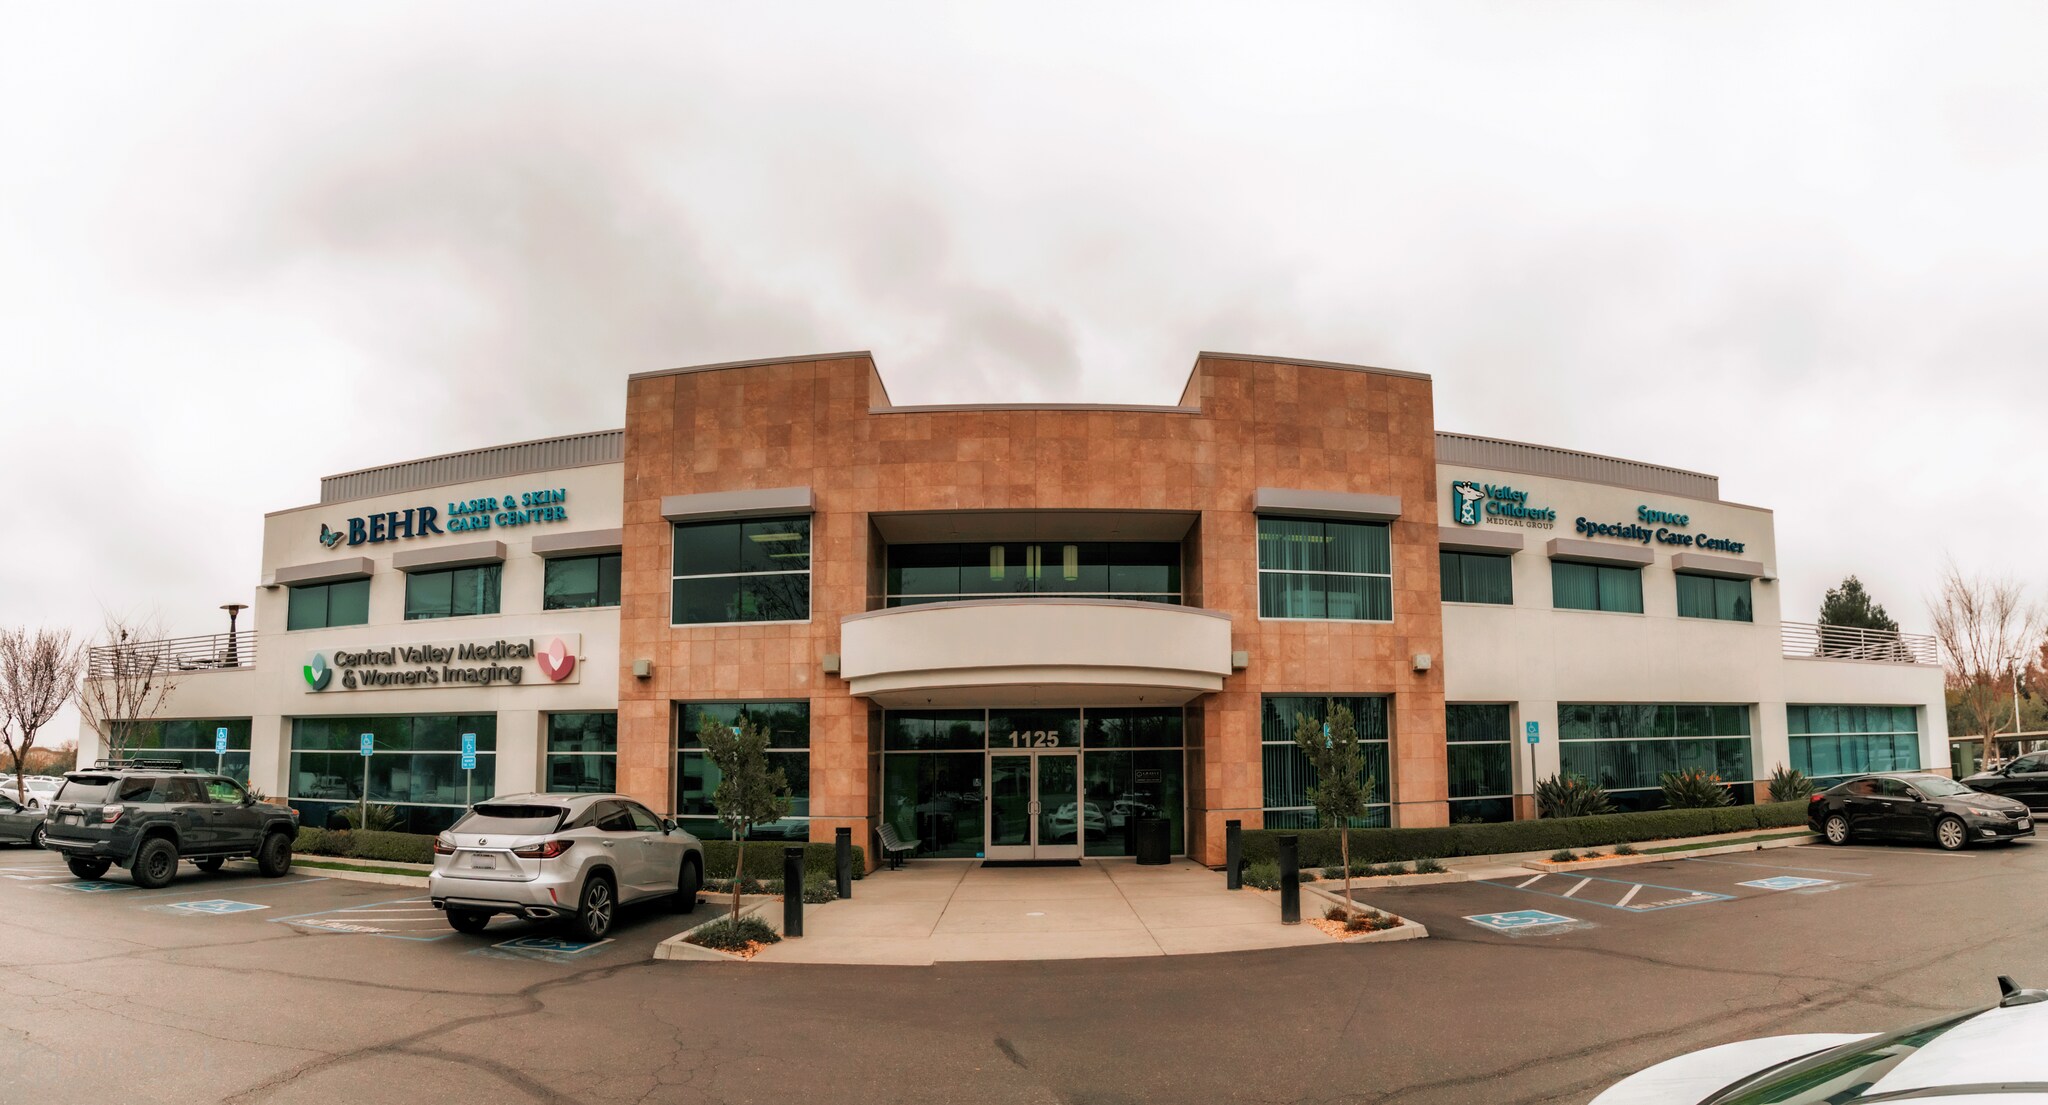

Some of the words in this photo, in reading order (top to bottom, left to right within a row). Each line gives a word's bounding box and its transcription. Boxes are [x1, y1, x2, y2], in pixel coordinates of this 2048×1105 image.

[448, 497, 499, 515] LASER
[502, 495, 517, 509] &
[521, 488, 566, 507] SKIN
[1484, 484, 1528, 504] Valley
[447, 514, 490, 532] CARE
[495, 506, 568, 527] CENTER
[1486, 500, 1556, 521] Children's
[1637, 505, 1690, 526] Spruce
[347, 506, 444, 545] BEHR
[1486, 517, 1524, 527] MEDICAL
[1526, 521, 1553, 530] GROUP
[1575, 517, 1653, 544] Specialty
[1655, 528, 1693, 546] Care
[1695, 534, 1745, 553] Center
[333, 647, 396, 667] Central
[398, 645, 454, 664] Valley
[457, 639, 535, 661] Medical
[342, 669, 357, 688] &
[359, 666, 439, 686] Women's
[442, 663, 523, 684] Imaging
[1008, 730, 1059, 748] 1125
